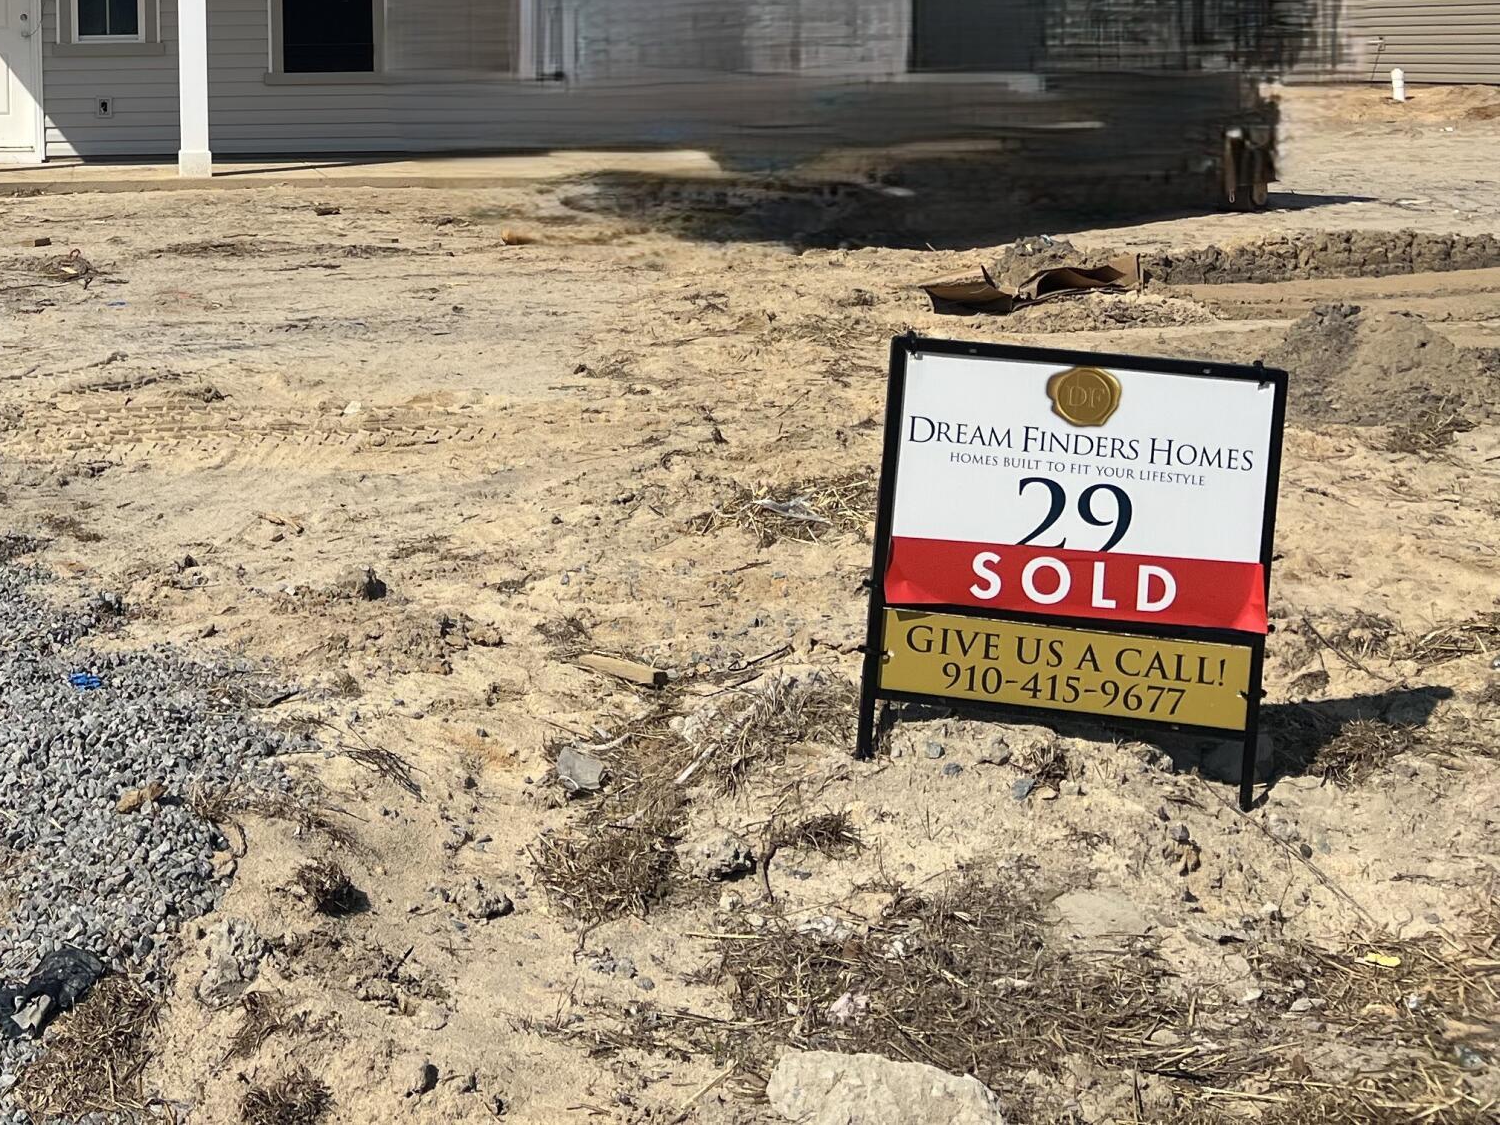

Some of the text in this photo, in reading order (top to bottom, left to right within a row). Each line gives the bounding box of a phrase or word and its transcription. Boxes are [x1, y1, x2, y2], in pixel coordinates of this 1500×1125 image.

[908, 415, 1254, 472] DREAM FINDERS HOMES
[950, 451, 1206, 487] HOMES BUILT TO FIT YOUR LIFESTYLE
[1015, 476, 1133, 553] 29
[969, 551, 1177, 612] SOLD
[906, 625, 1226, 687] GIVE US A CALL!
[942, 662, 1186, 715] 910-415-9677
